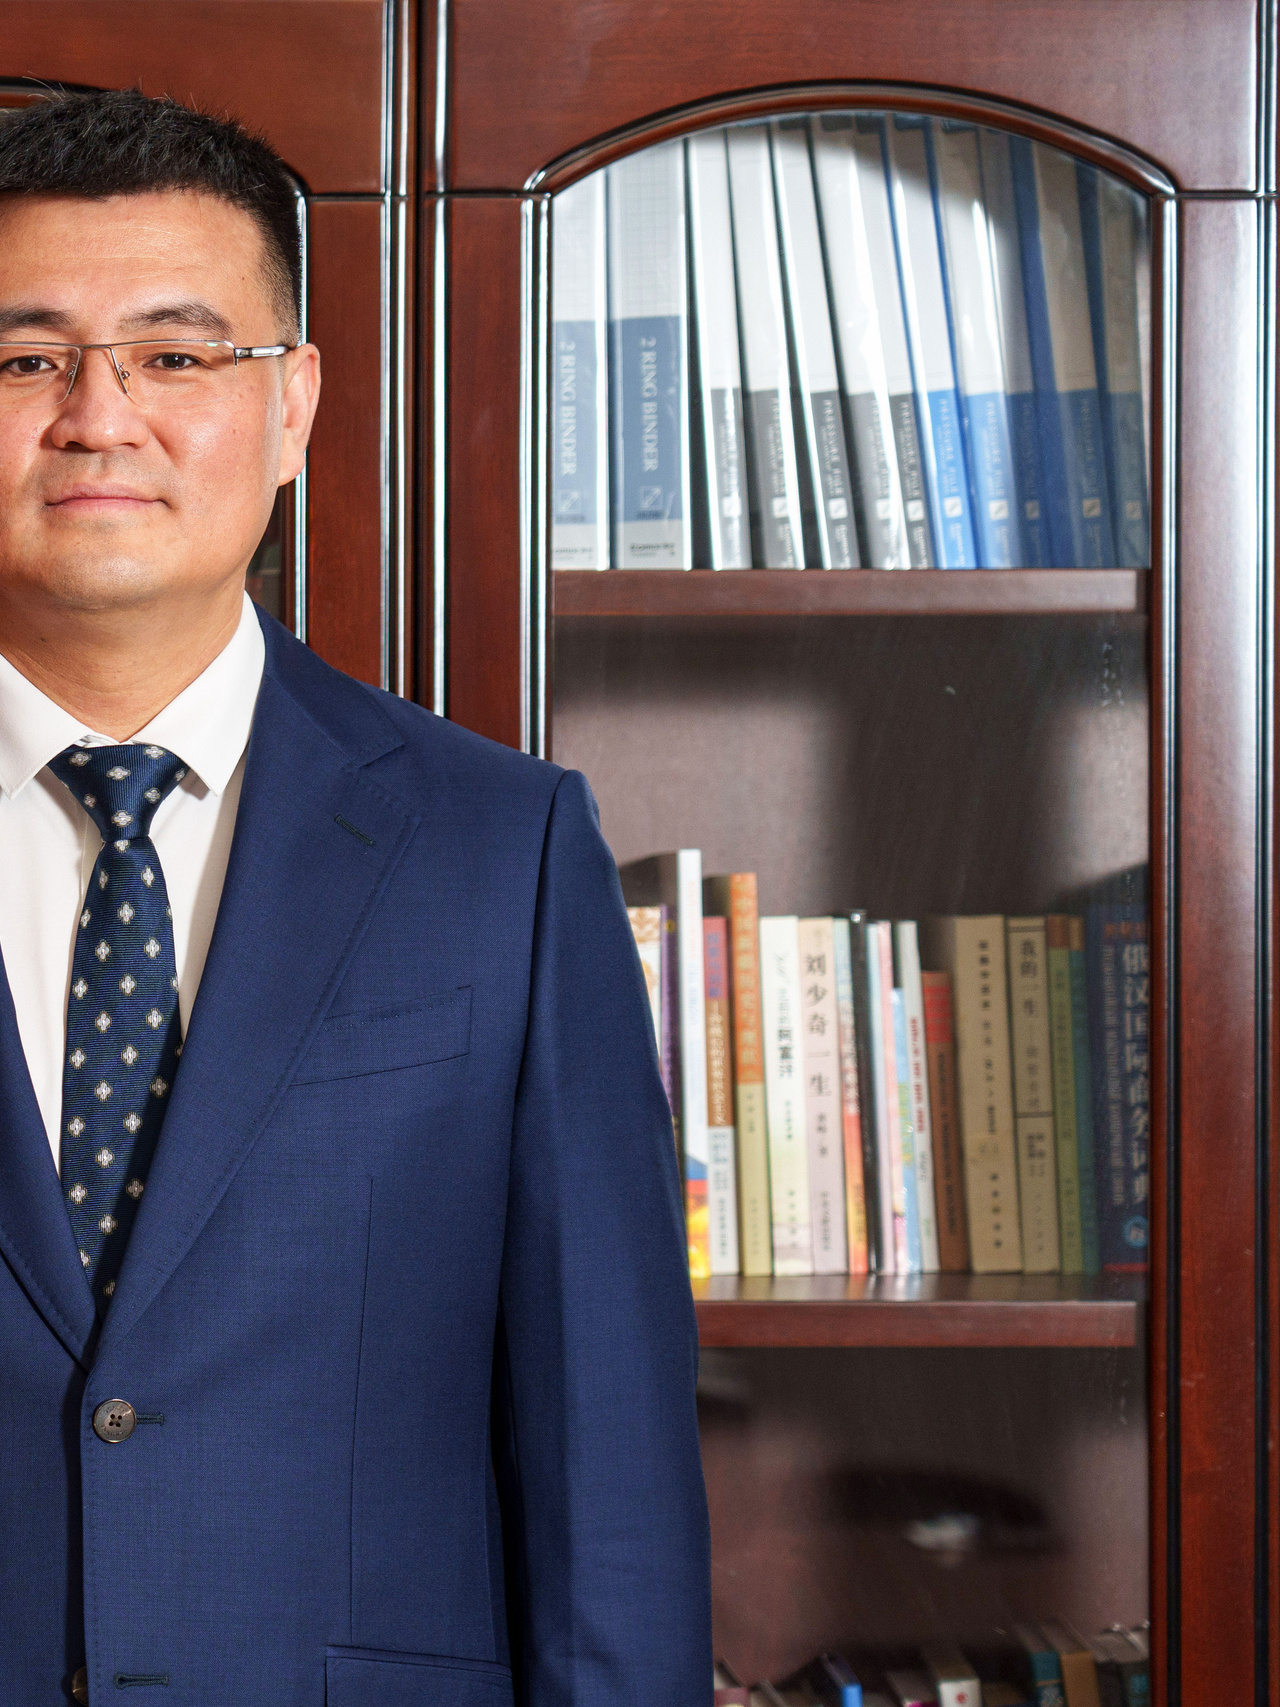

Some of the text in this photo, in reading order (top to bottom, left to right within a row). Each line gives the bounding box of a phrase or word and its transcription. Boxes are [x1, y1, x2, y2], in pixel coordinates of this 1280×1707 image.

[560, 341, 578, 476] 2 RING BINDER
[641, 337, 659, 472] 2 RING BINDER
[806, 952, 832, 1098] 刘少奇一生
